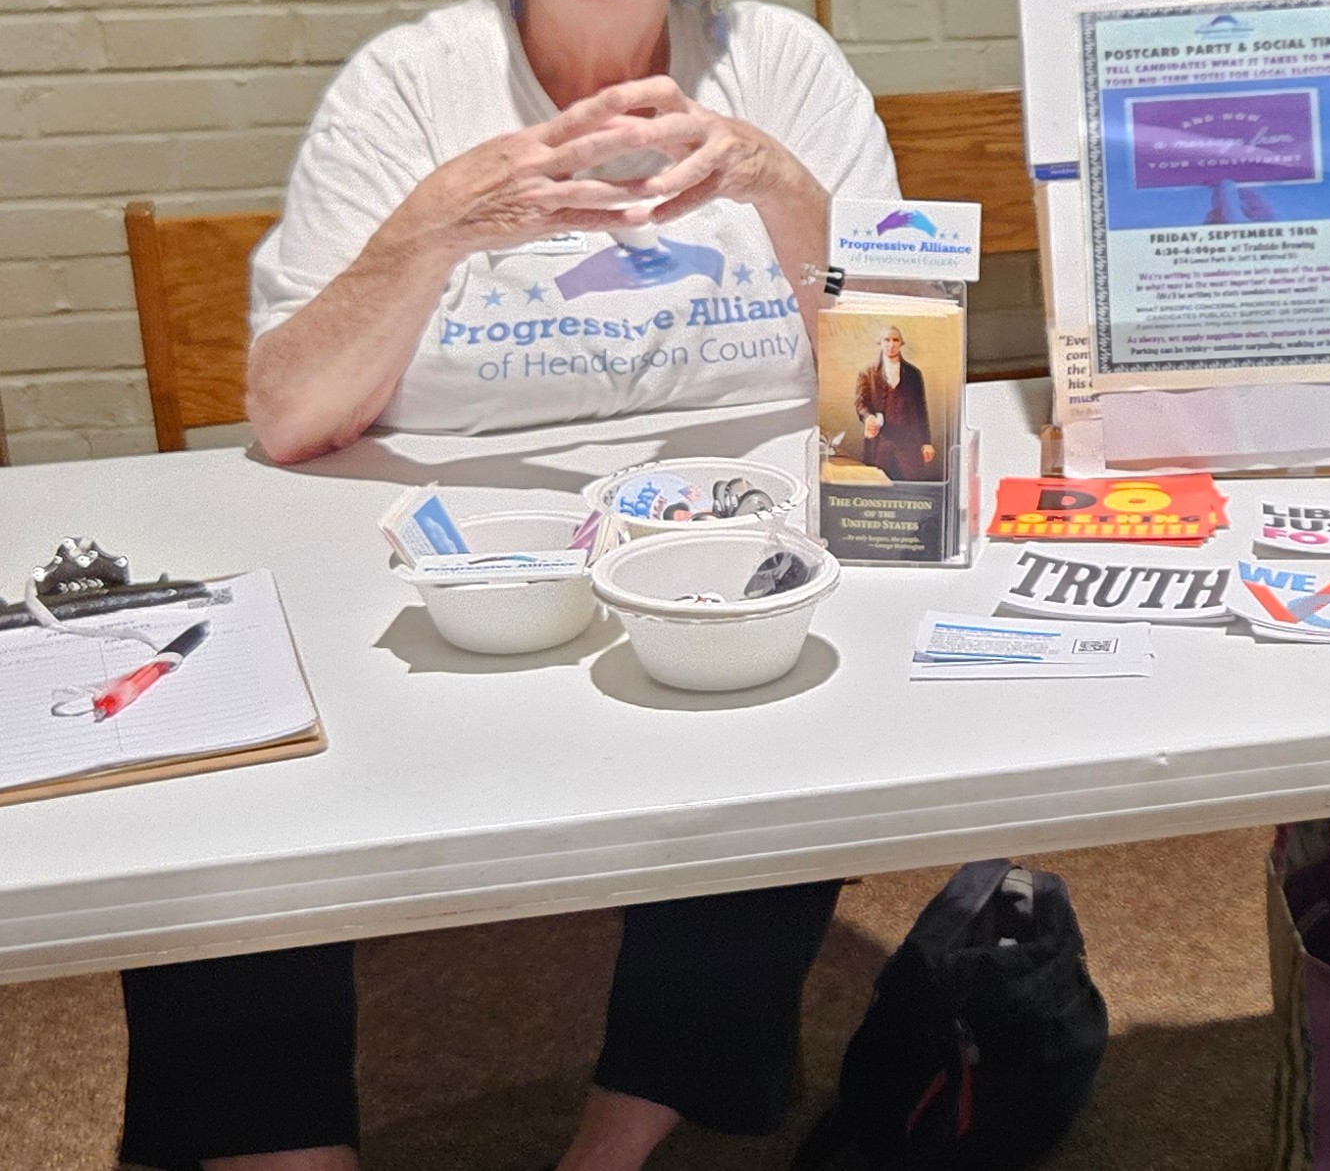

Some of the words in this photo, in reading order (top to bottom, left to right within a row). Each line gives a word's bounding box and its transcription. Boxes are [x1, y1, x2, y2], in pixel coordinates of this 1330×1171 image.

[1104, 47, 1180, 61] POSTCARD
[1186, 43, 1232, 56] PARTY
[1237, 42, 1247, 52] &
[1253, 38, 1306, 52] SOCIAL
[1105, 66, 1131, 75] TELL
[1135, 60, 1207, 74] CANDIDATES
[1211, 58, 1244, 67] WHAT
[1263, 55, 1299, 65] TAKES
[1303, 53, 1318, 63] TO
[1105, 78, 1134, 87] YOUR
[1138, 74, 1189, 84] MID-TERM
[1193, 72, 1226, 81] VOTES
[1229, 70, 1250, 80] FOR
[1253, 68, 1288, 78] LOCAL
[1149, 232, 1204, 244] FRIDAY,
[1208, 227, 1284, 242] SEPTEMBER
[839, 237, 916, 252] Progressive
[919, 241, 972, 254] Alliance
[1203, 269, 1242, 278] candidates
[1145, 283, 1165, 291] what
[1195, 280, 1207, 288] the
[1230, 277, 1267, 287] important
[440, 309, 675, 350] Progressive
[687, 295, 801, 327] Allianc
[479, 352, 514, 381] of
[525, 345, 690, 378] Henderson
[700, 333, 800, 364] County
[1130, 347, 1159, 355] Parking
[1067, 365, 1087, 375] the
[1068, 378, 1086, 389] his
[828, 495, 852, 507] THE
[852, 496, 933, 510] CONSTITUTION
[878, 510, 897, 518] THE
[1000, 513, 1201, 524] SOMETHING
[841, 517, 881, 529] UNITED
[882, 519, 919, 530] STATES
[1008, 551, 1232, 610] TRUTH
[1239, 561, 1317, 593] WE
